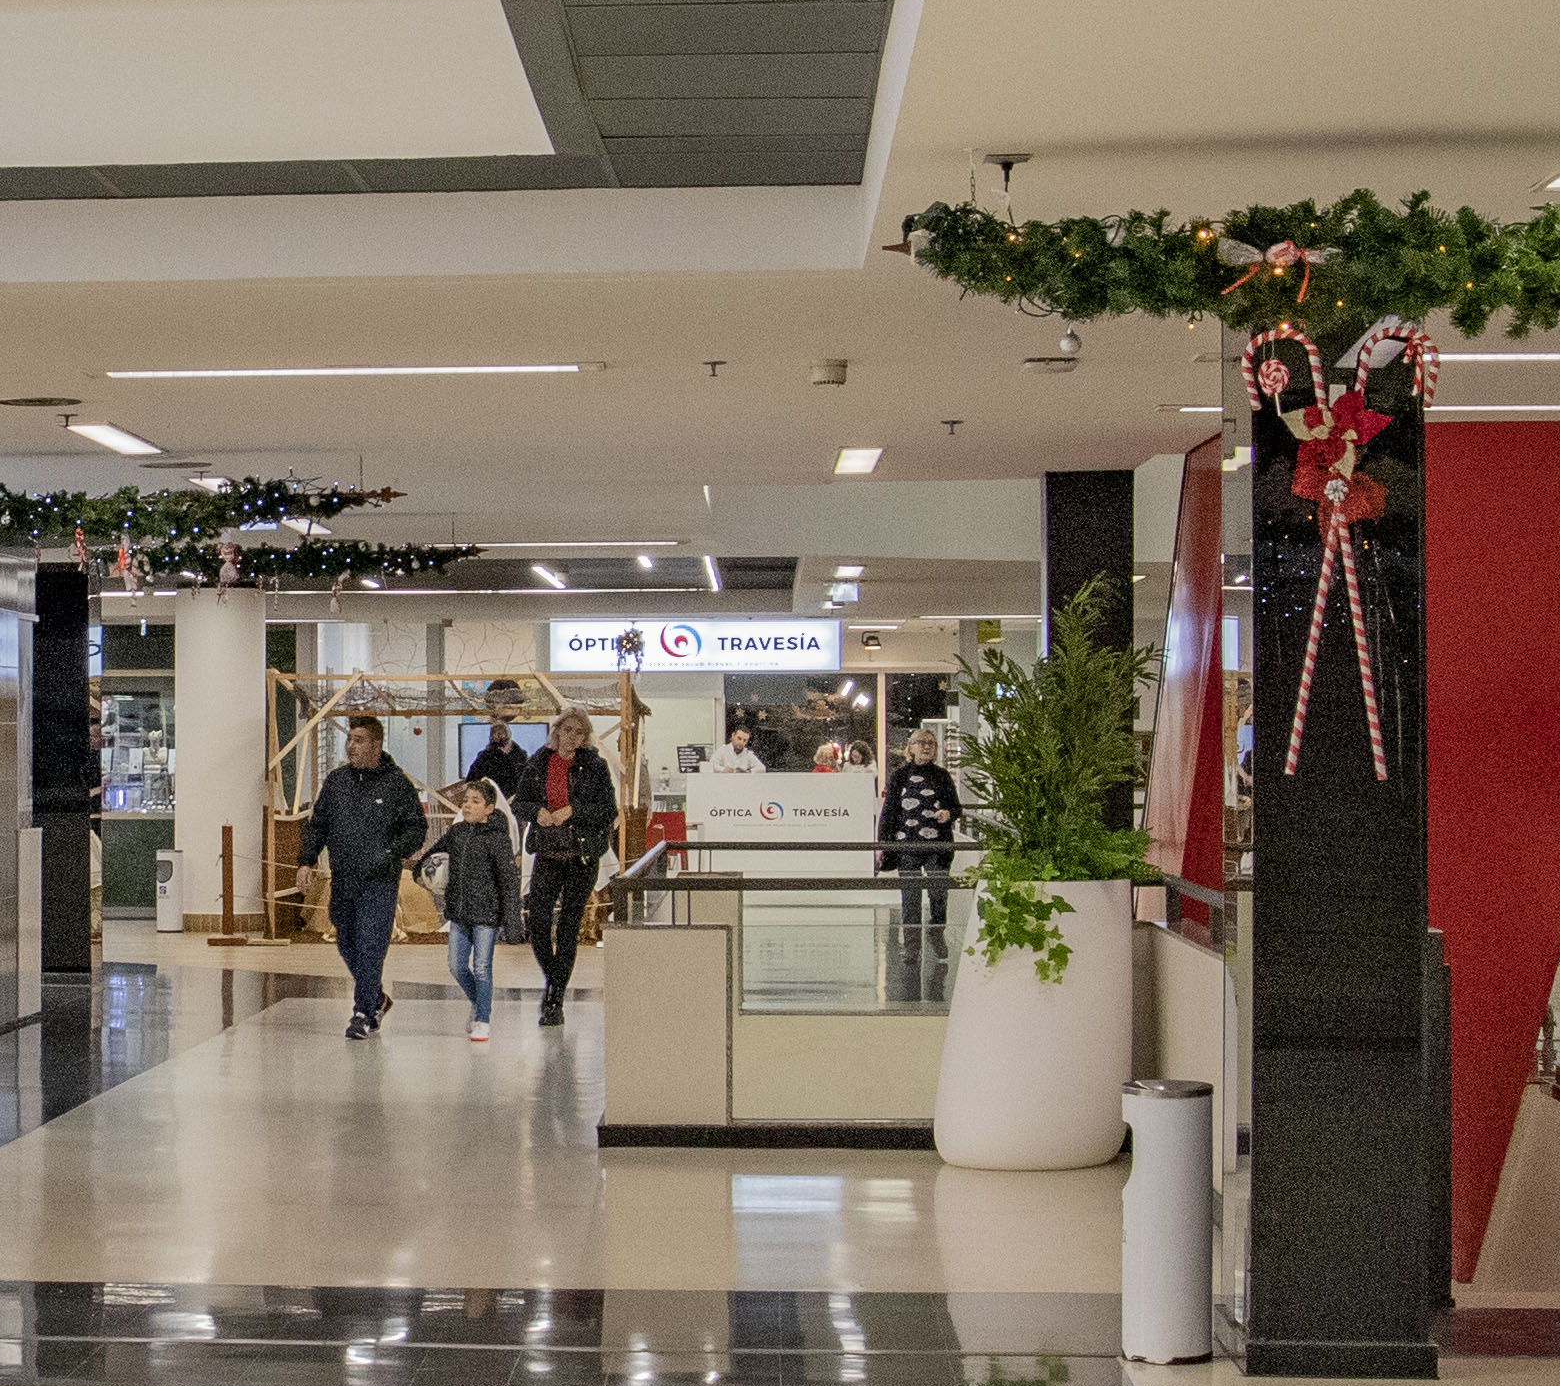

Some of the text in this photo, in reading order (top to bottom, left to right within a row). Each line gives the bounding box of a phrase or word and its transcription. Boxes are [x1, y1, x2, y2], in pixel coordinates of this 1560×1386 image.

[568, 631, 821, 652] ÓPTI TRAVESÍA
[709, 805, 851, 818] ÓPTICA TRAVESÍA
